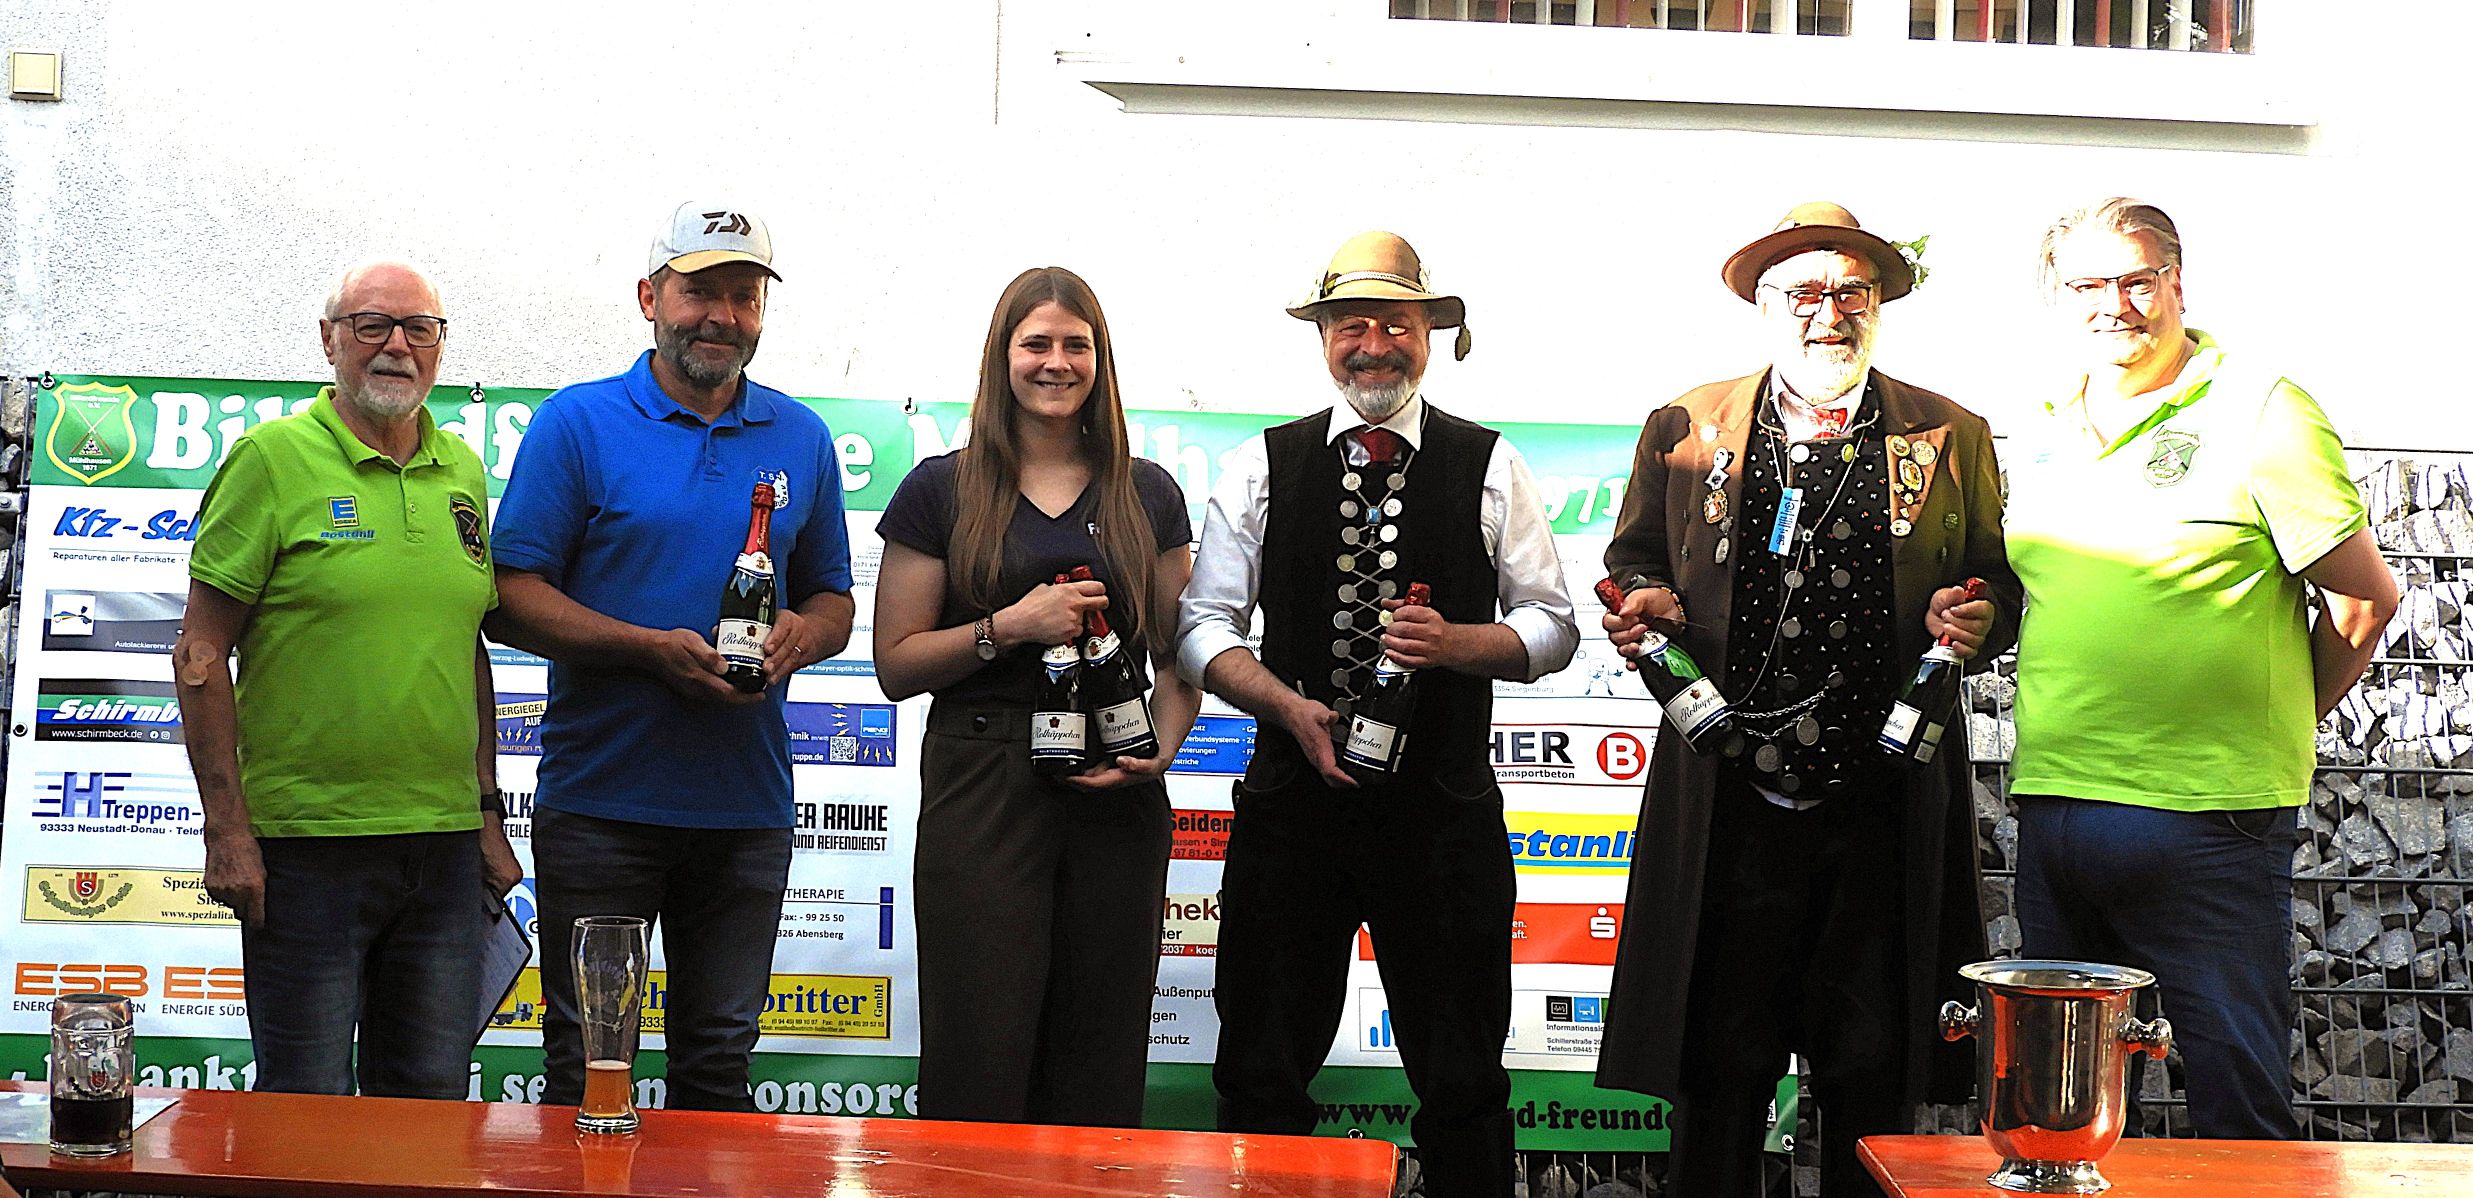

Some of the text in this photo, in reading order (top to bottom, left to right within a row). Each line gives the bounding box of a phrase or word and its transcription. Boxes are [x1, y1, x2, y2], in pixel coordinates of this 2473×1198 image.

[53, 552, 176, 563] Reparaturen aller Fabrikate
[51, 729, 143, 739] www.schirmbeck.de
[823, 803, 888, 832] RAUHE
[40, 823, 75, 832] 93333
[77, 823, 166, 834] Neustadt-Donau
[817, 835, 887, 852] REIFENDIENST
[786, 888, 845, 900] THERAPIE
[805, 913, 817, 922] 99
[819, 913, 831, 922] 25
[832, 914, 845, 922] 50
[795, 930, 844, 940] Abensberg
[1161, 945, 1185, 955] 2037
[14, 961, 150, 997] ESB
[873, 984, 884, 1018] GmbH
[161, 1004, 215, 1016] ENERGIE
[1547, 1045, 1572, 1053] Telefon
[747, 1079, 919, 1116] onsore
